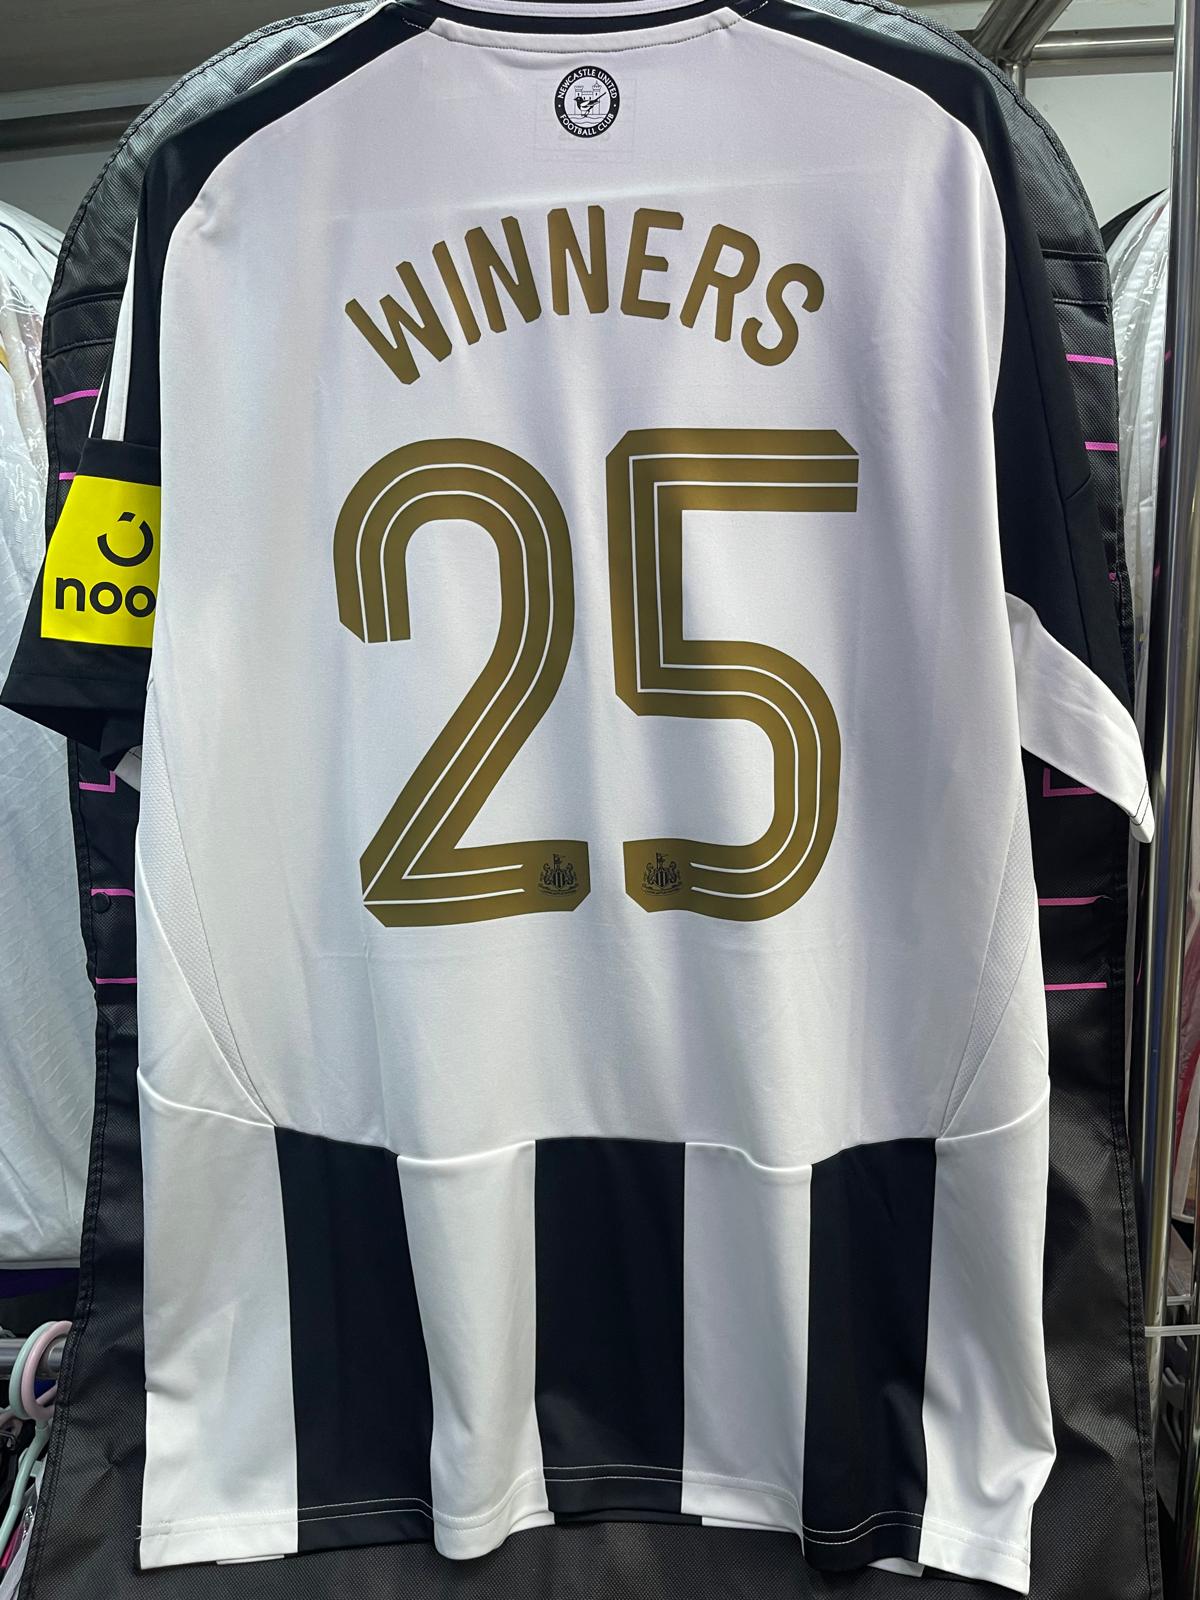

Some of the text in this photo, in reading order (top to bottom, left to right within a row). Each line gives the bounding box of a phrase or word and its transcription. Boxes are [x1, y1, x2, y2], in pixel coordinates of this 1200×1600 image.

[557, 68, 618, 99] NEWCASTLE UNITED
[560, 113, 615, 136] FOOTBALL CLUB
[346, 206, 824, 384] WINNERS
[334, 428, 858, 926] 25
